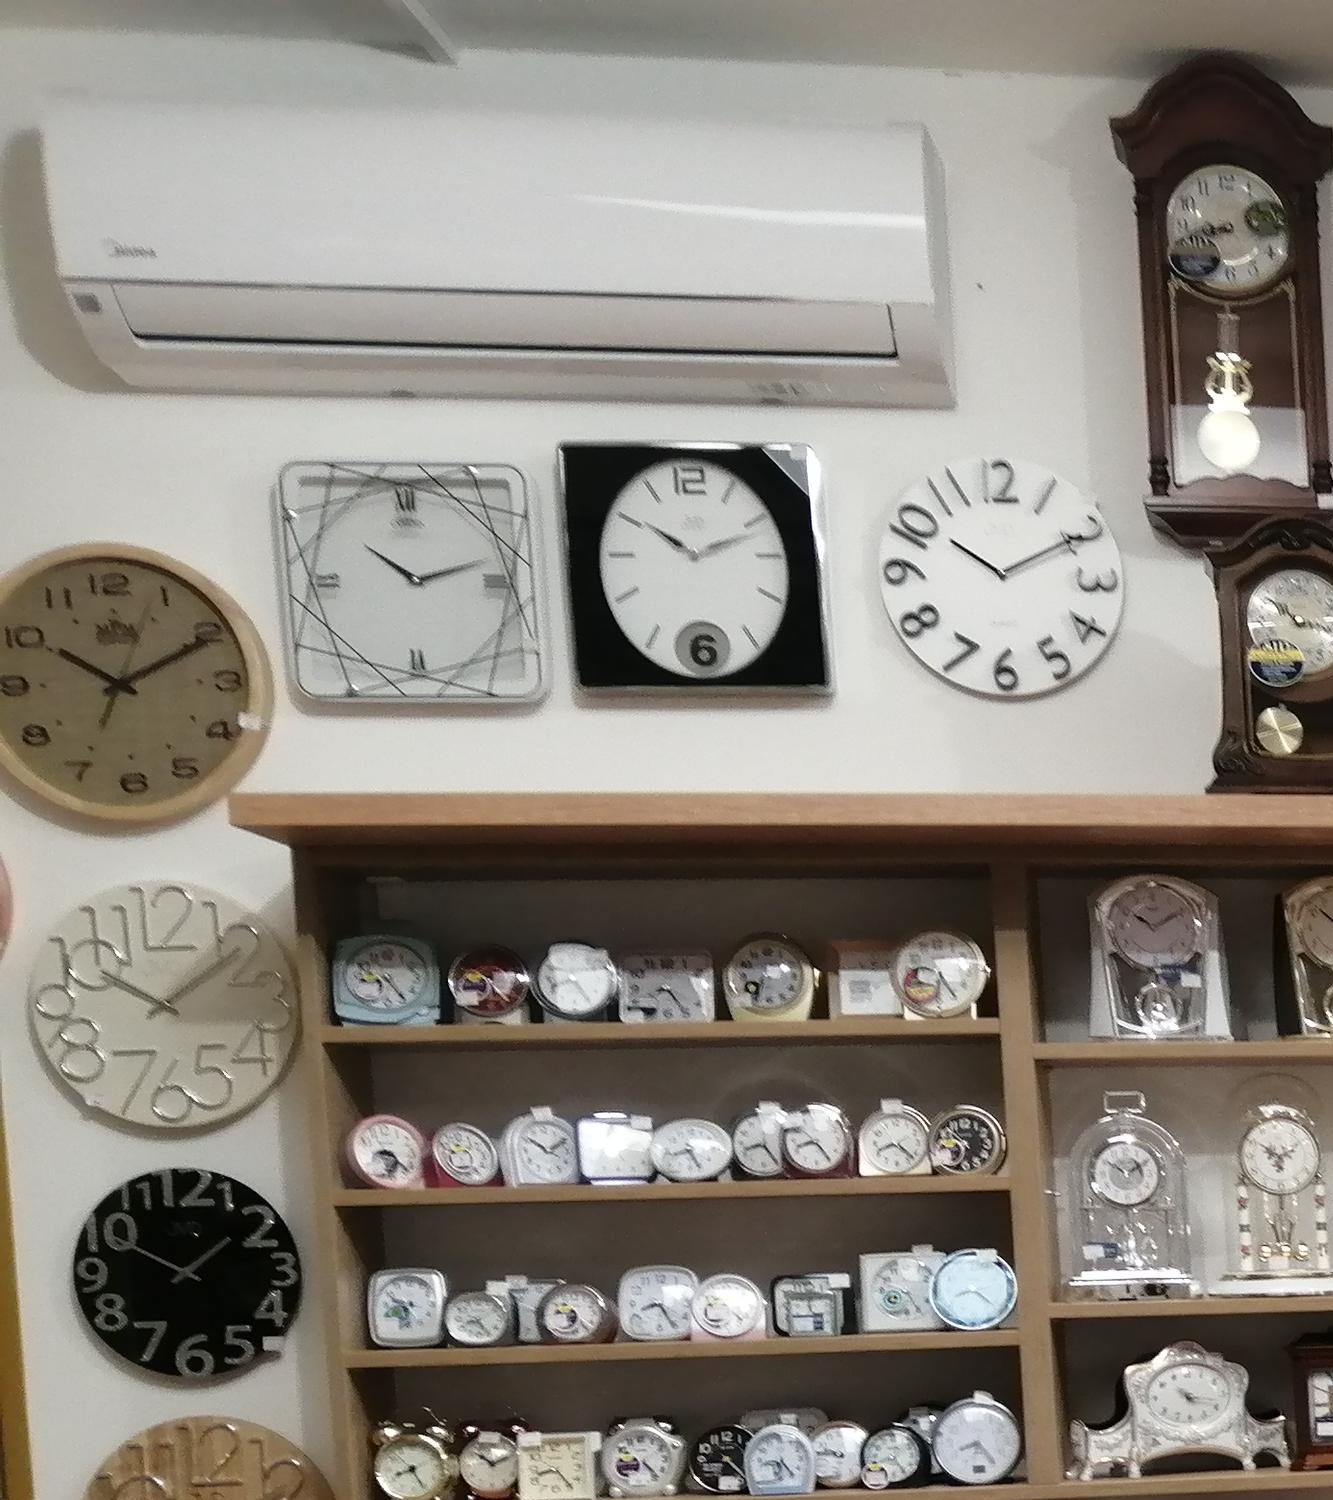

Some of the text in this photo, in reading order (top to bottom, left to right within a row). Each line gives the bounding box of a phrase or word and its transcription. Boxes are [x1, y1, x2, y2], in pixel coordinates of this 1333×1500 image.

[673, 465, 707, 496] 12
[927, 465, 971, 517] 11
[981, 459, 1020, 504] 12
[1034, 476, 1057, 515] 1
[889, 503, 939, 551] 10
[88, 573, 133, 596] 12
[884, 558, 926, 586] 9
[1077, 567, 1118, 592] 3
[45, 586, 73, 609] 11
[160, 585, 169, 606] 1
[4, 625, 44, 648] 10
[900, 603, 939, 639] 8
[1068, 608, 1107, 644] 4
[689, 634, 718, 667] 6
[943, 631, 980, 673] 7
[994, 647, 1019, 691] 6
[1037, 634, 1071, 681] 5
[0, 675, 30, 697] 9
[214, 670, 242, 692] 3
[21, 724, 51, 746] 8
[206, 720, 243, 740] 4
[64, 760, 93, 782] 7
[119, 772, 148, 794] 6
[171, 757, 199, 779] 5
[80, 904, 133, 966] 11
[129, 886, 198, 952] 12
[202, 900, 223, 944] 1
[48, 937, 122, 998] 10
[219, 924, 266, 988] 2
[36, 984, 75, 1048] 9
[250, 970, 291, 1031] 3
[59, 1017, 106, 1083] 8
[231, 1019, 273, 1077] 4
[111, 1050, 156, 1116] 7
[152, 1059, 192, 1122] 6
[194, 1044, 233, 1110] 5
[120, 1182, 152, 1210] 11
[152, 1168, 215, 1207] 12
[216, 1181, 235, 1211] 1
[86, 1212, 138, 1252] 10
[242, 1205, 279, 1248] 2
[77, 1257, 108, 1293] 9
[270, 1252, 298, 1287] 3
[94, 1293, 129, 1332] 8
[255, 1289, 288, 1327] 4
[133, 1321, 168, 1362] 7
[175, 1334, 215, 1377] 6
[224, 1325, 255, 1365] 5
[174, 1424, 243, 1487] 12
